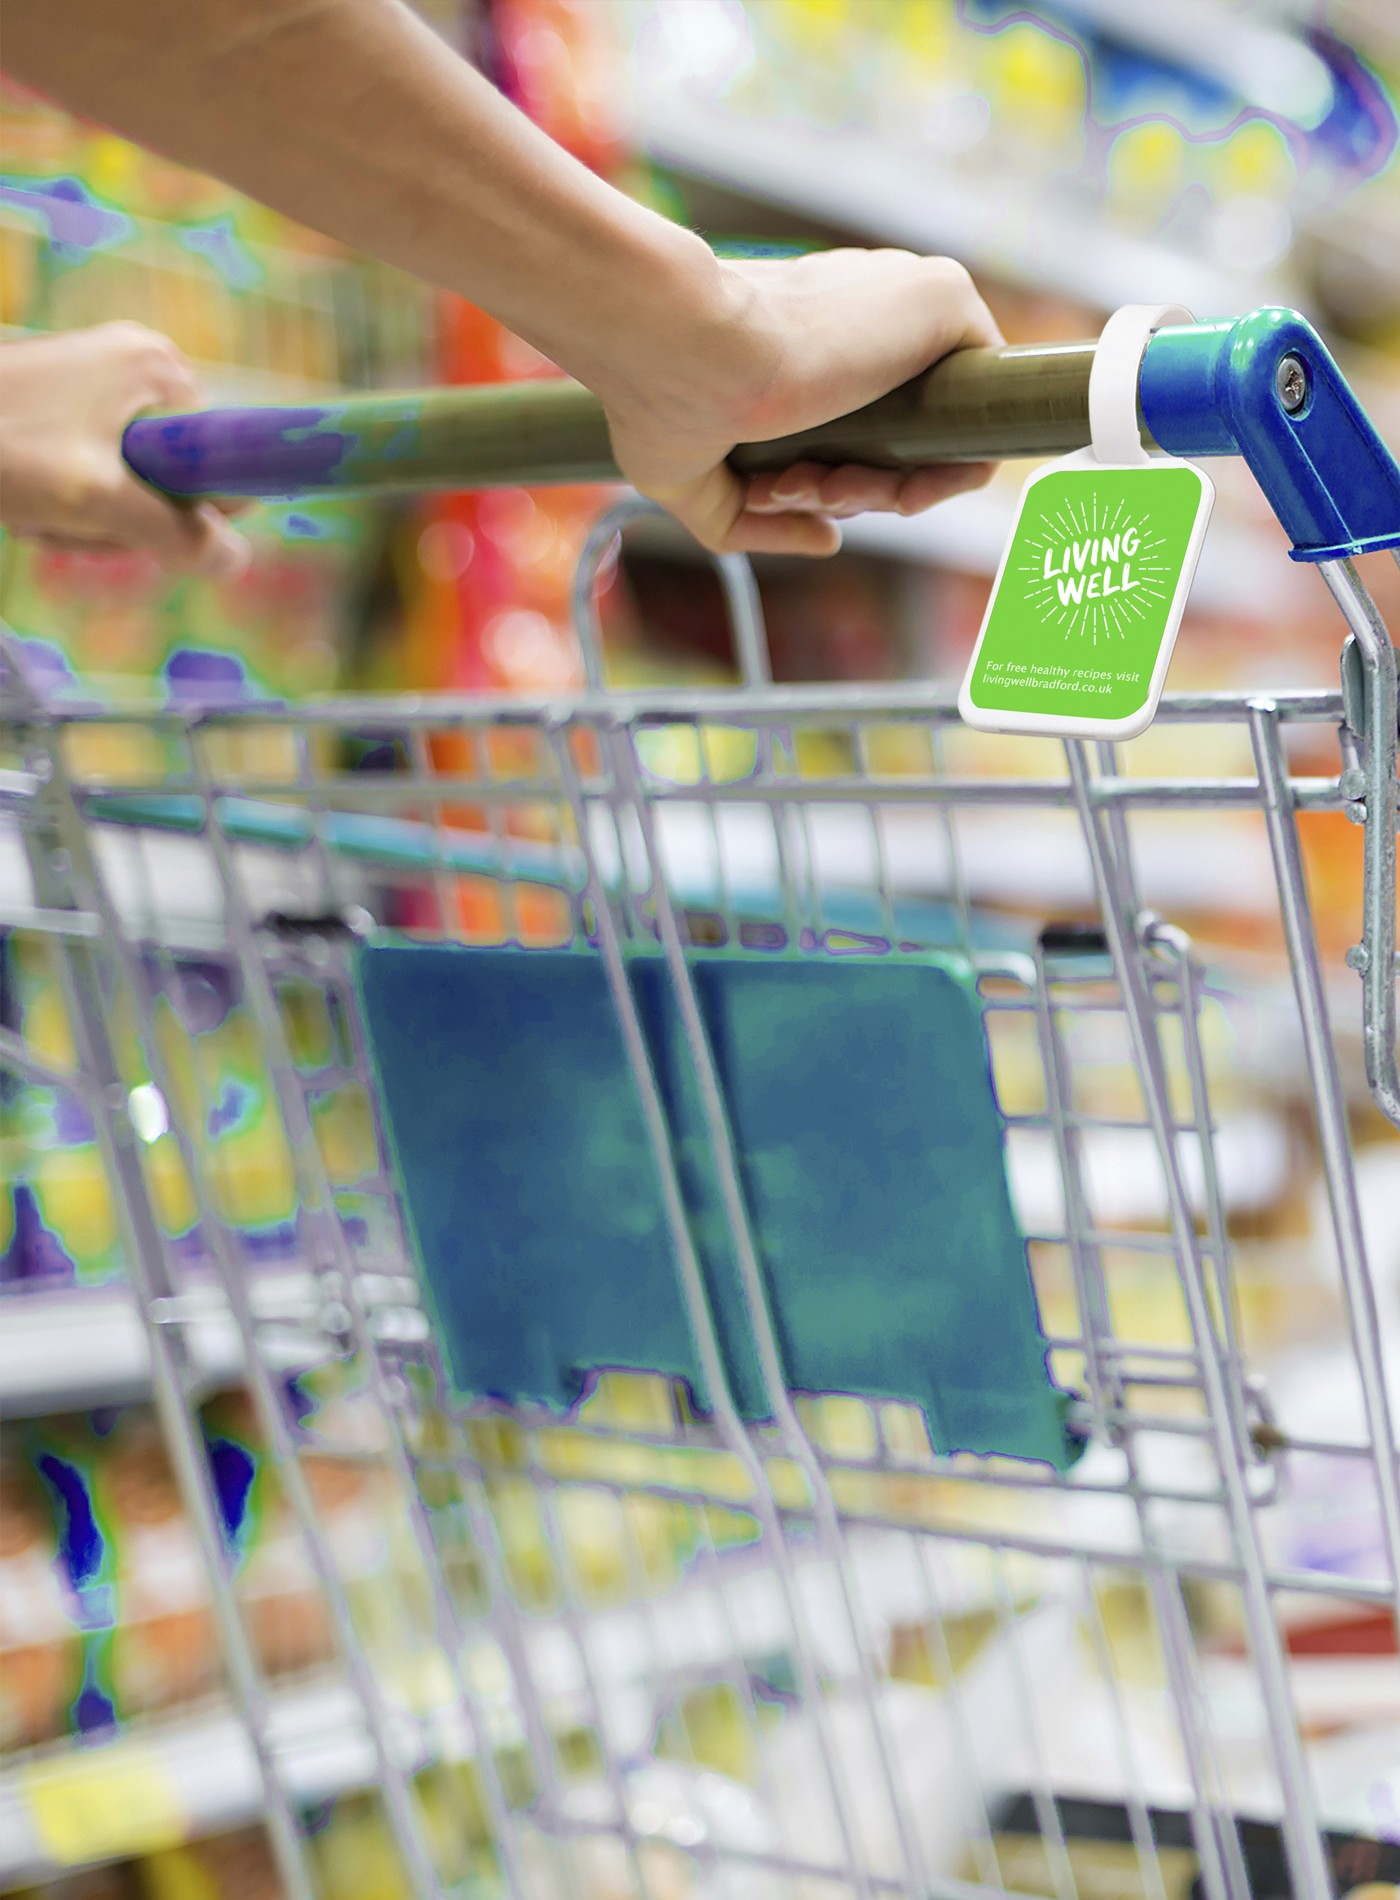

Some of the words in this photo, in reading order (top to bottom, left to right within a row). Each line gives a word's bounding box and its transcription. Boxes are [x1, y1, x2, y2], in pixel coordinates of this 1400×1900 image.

[1043, 527, 1141, 580] LIVING
[1057, 562, 1141, 606] WELL
[982, 673, 1113, 694] livingwellbradford.co.uk
[986, 660, 1003, 672] For
[1006, 661, 1027, 673] free
[1030, 664, 1070, 678] healthy
[1073, 668, 1112, 681] recipes
[1116, 671, 1140, 683] visit
